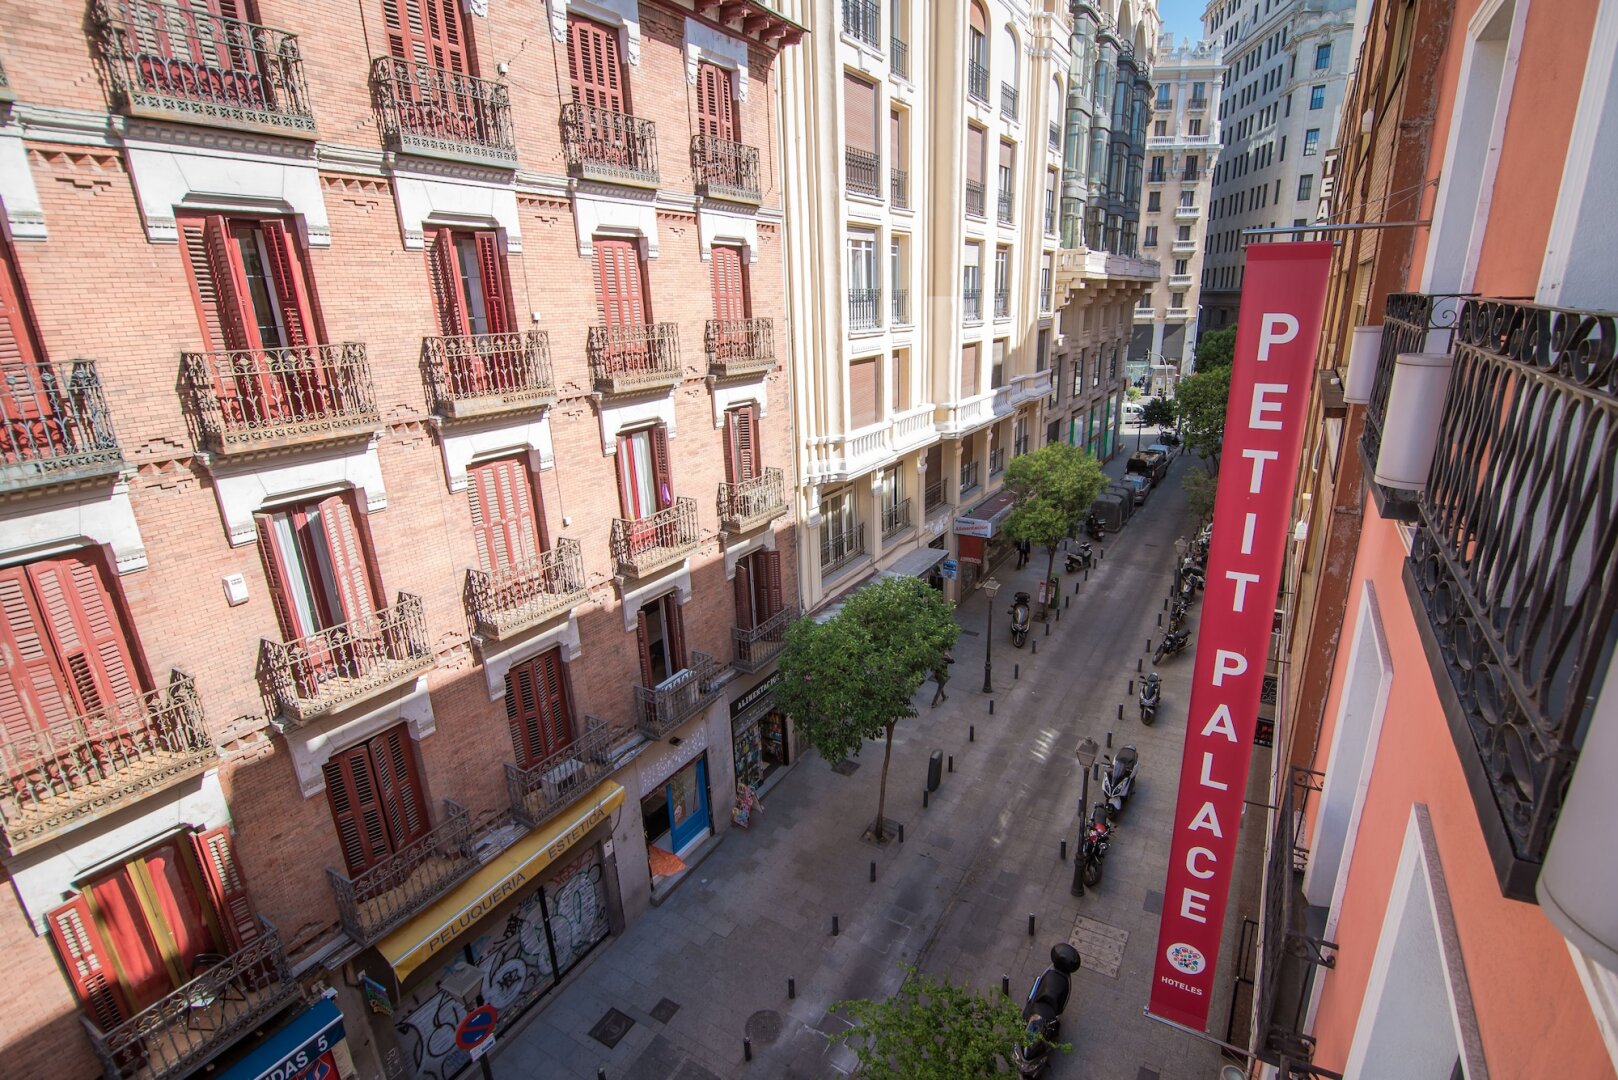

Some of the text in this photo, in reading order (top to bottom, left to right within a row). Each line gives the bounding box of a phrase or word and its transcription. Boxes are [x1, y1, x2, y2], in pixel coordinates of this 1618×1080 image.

[1180, 312, 1300, 923] PETIT PALACE
[428, 872, 527, 953] PELUQUERIA
[547, 808, 606, 860] ESTETICA
[1161, 976, 1203, 996] HOTELES
[264, 1035, 329, 1080] DAS 5
